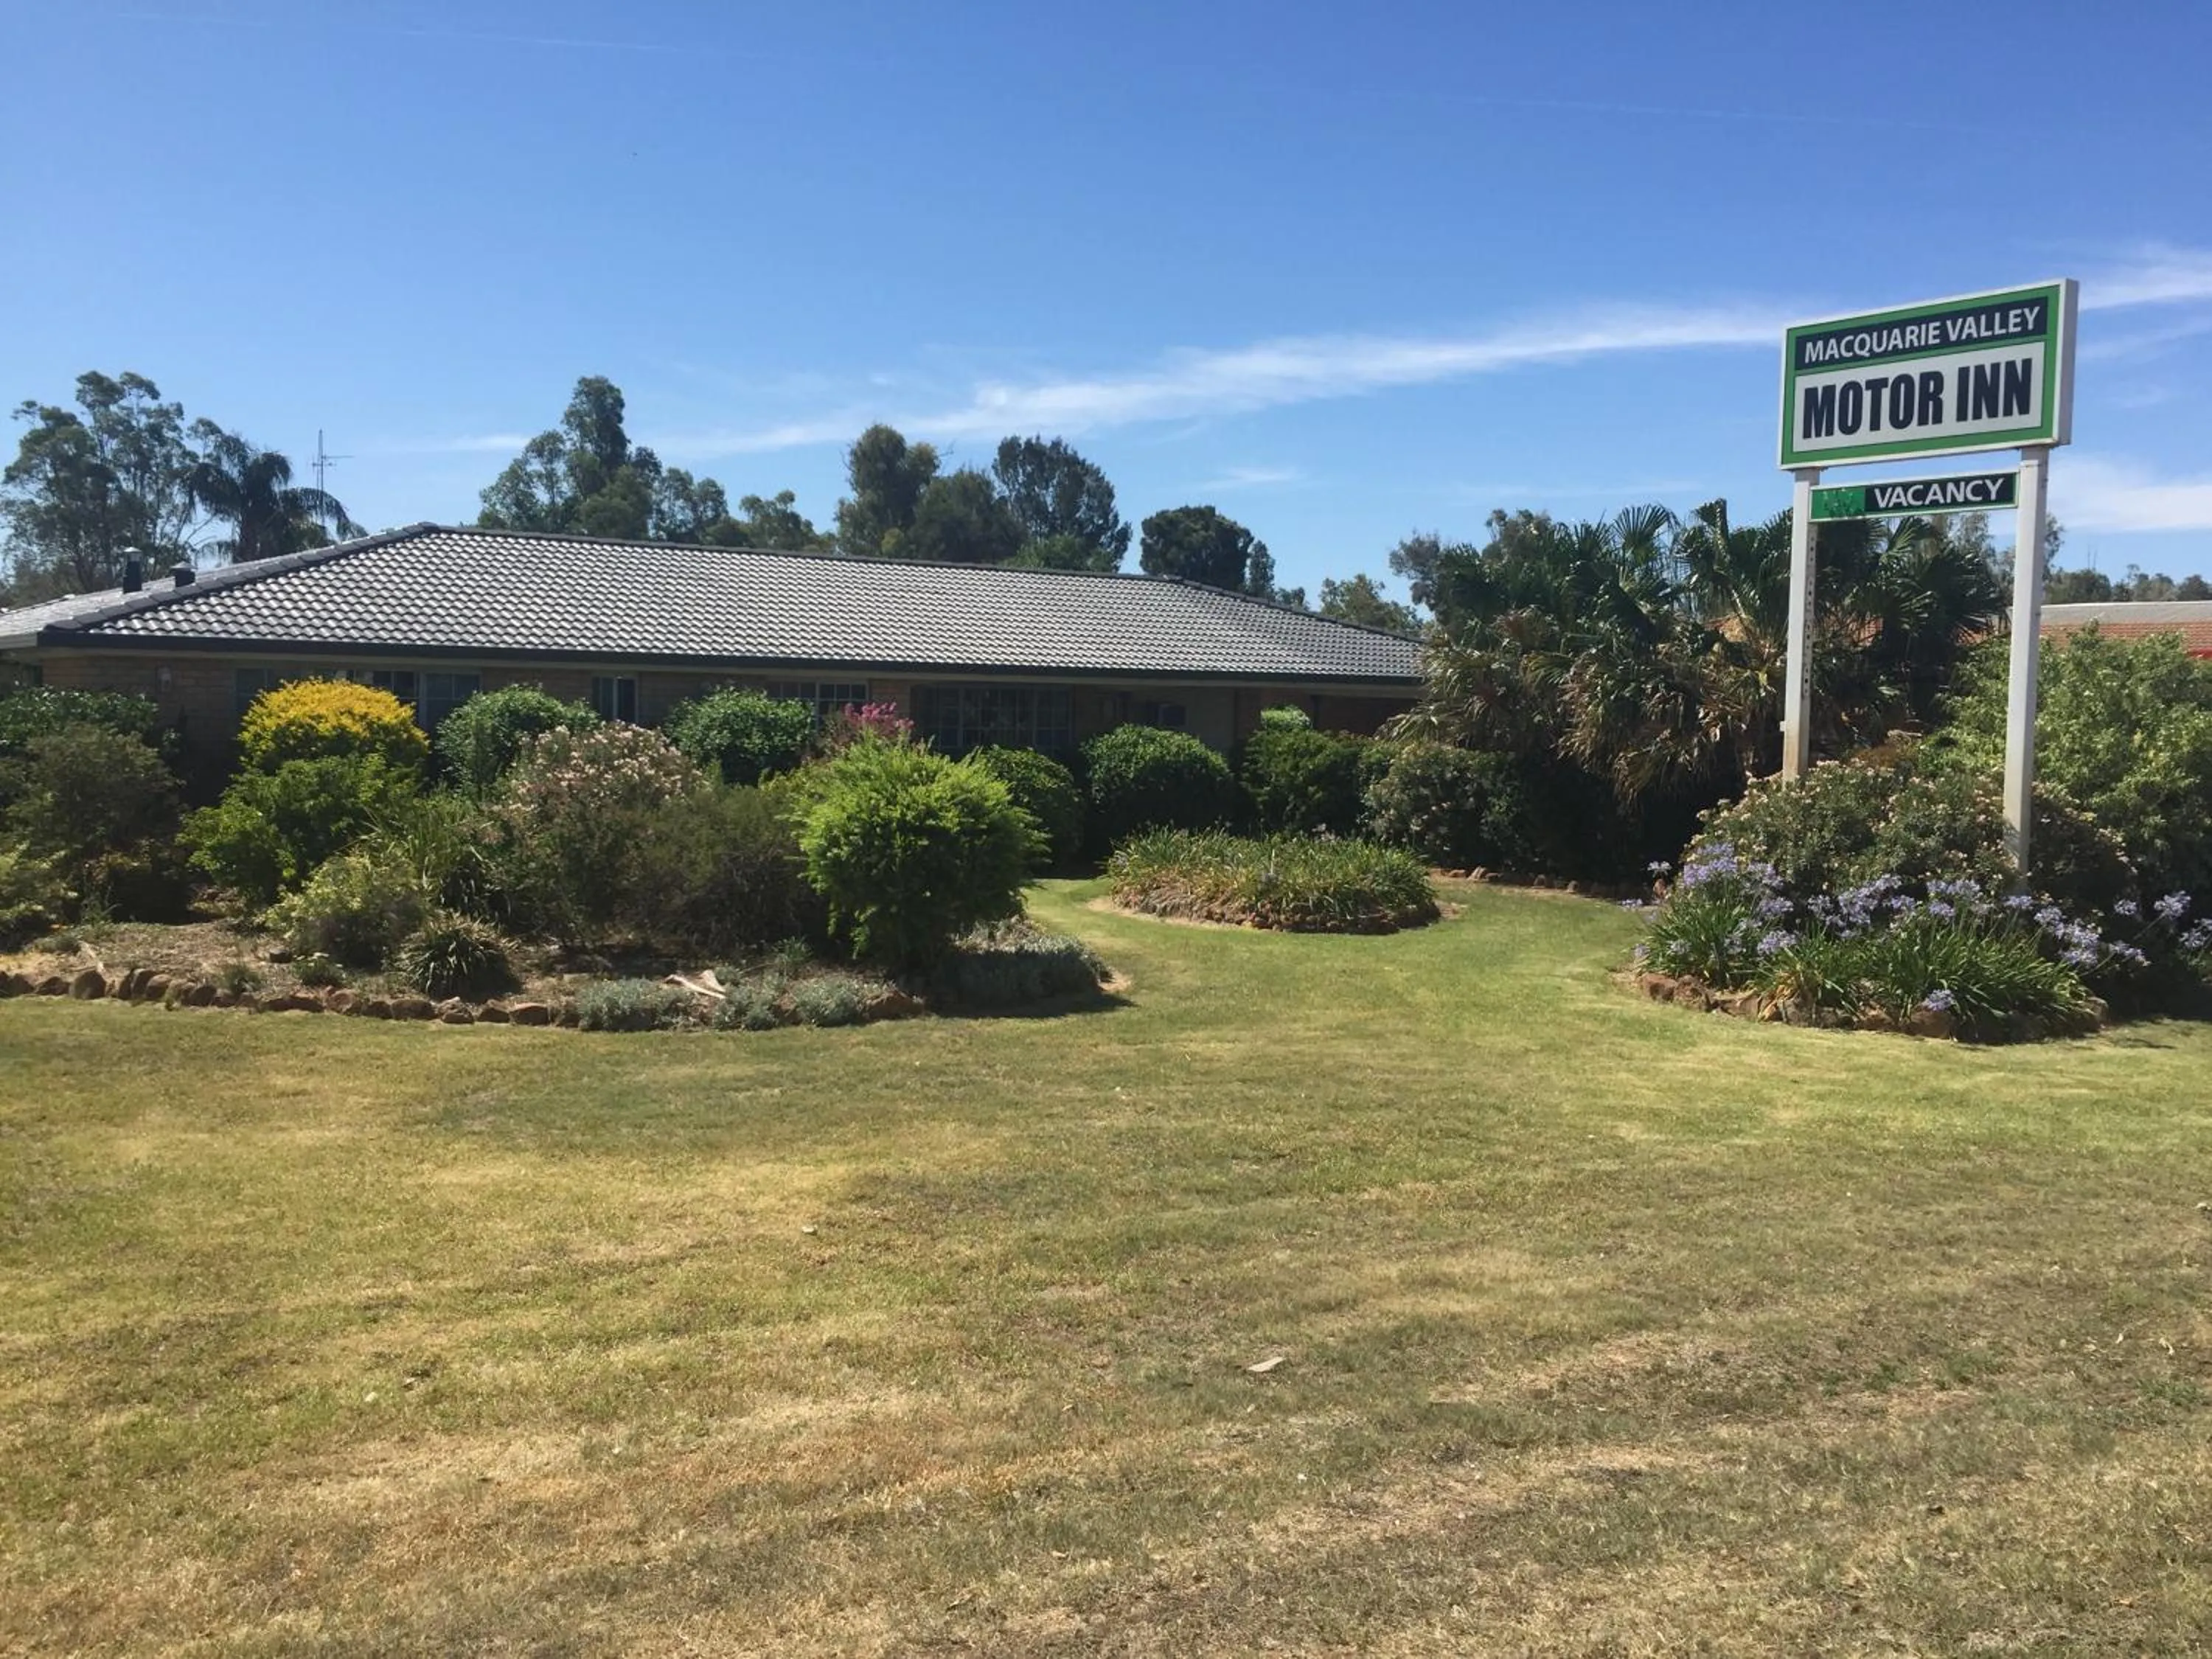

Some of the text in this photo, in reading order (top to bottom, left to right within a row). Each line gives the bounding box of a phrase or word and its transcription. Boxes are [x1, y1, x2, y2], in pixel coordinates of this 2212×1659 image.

[1804, 306, 2040, 364] MACQUARIE VALLEY
[1803, 358, 2033, 439] MOTOR INN
[1874, 477, 2006, 509] VACANCY
